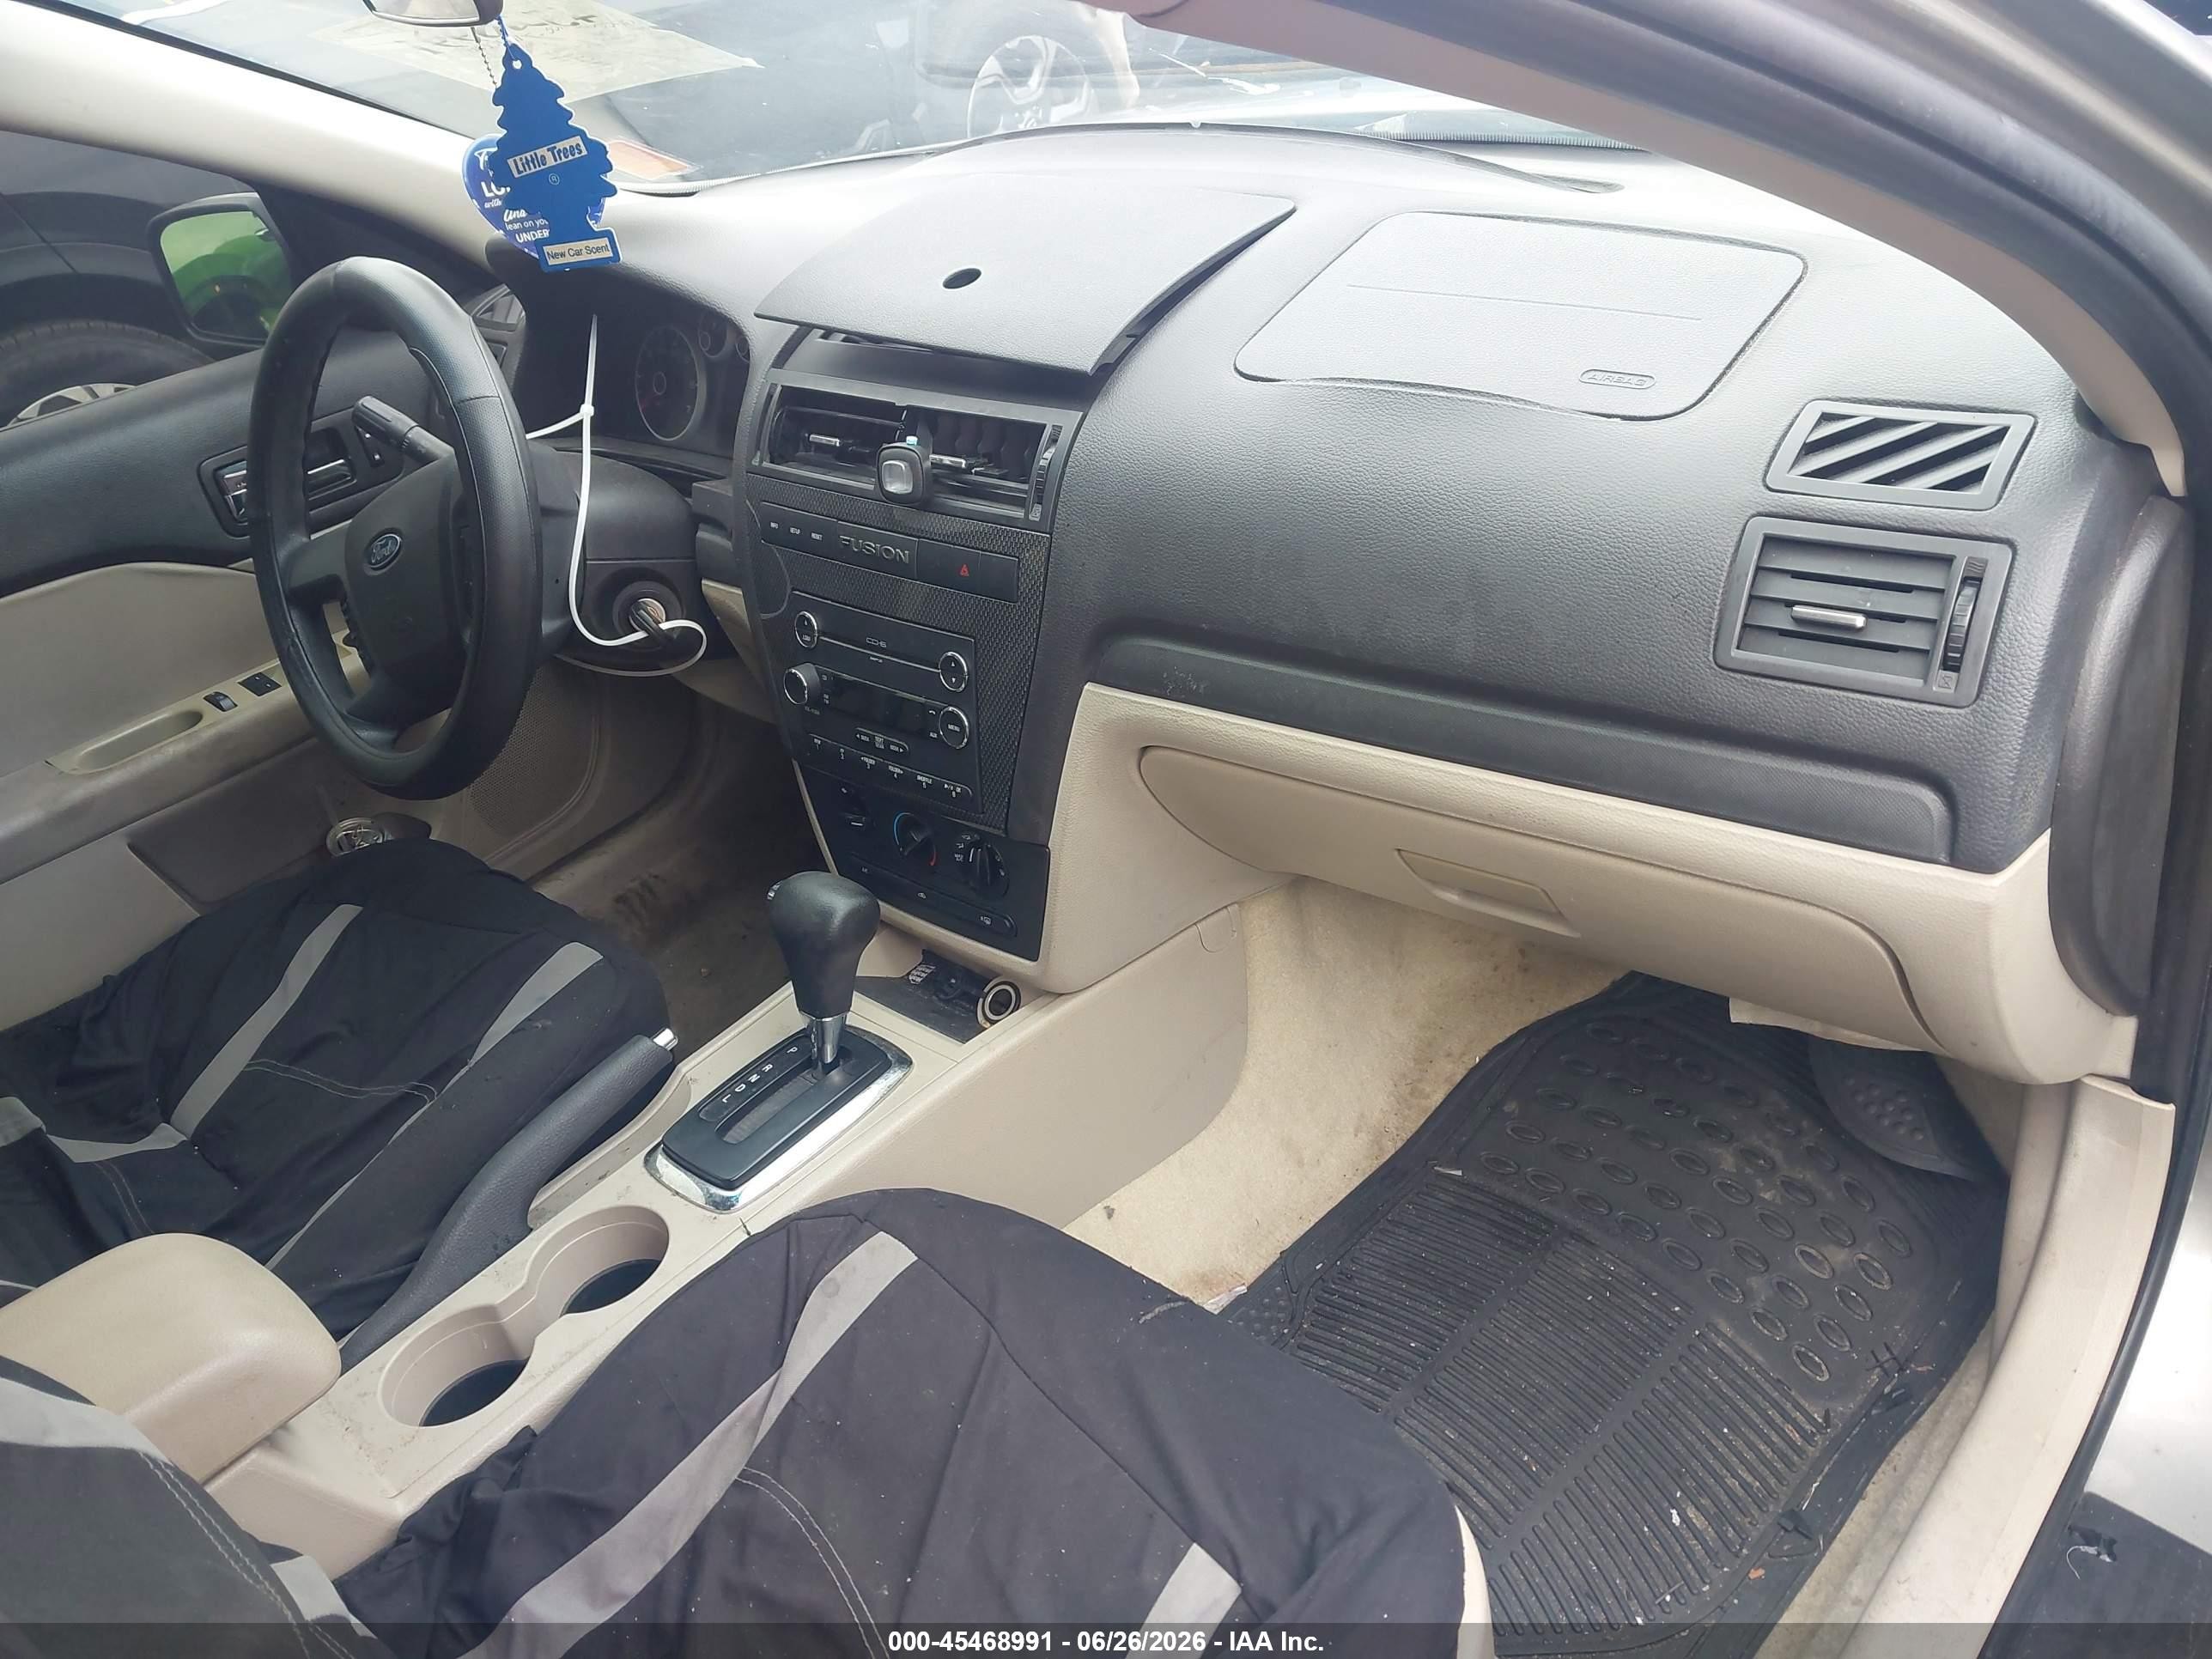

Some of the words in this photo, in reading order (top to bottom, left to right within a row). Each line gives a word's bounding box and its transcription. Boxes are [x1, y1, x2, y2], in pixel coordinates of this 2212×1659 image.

[514, 152, 547, 174] Little
[548, 142, 583, 162] Trees
[505, 221, 523, 231] lean
[524, 220, 534, 228] on
[546, 250, 566, 260] New
[568, 246, 583, 258] Car
[584, 243, 611, 255] Scent
[1587, 374, 1648, 386] AIRBAG
[839, 534, 910, 565] FUSION
[762, 1064, 773, 1073] R
[748, 1073, 761, 1083] N
[734, 1083, 746, 1092] D
[722, 1094, 732, 1103] L
